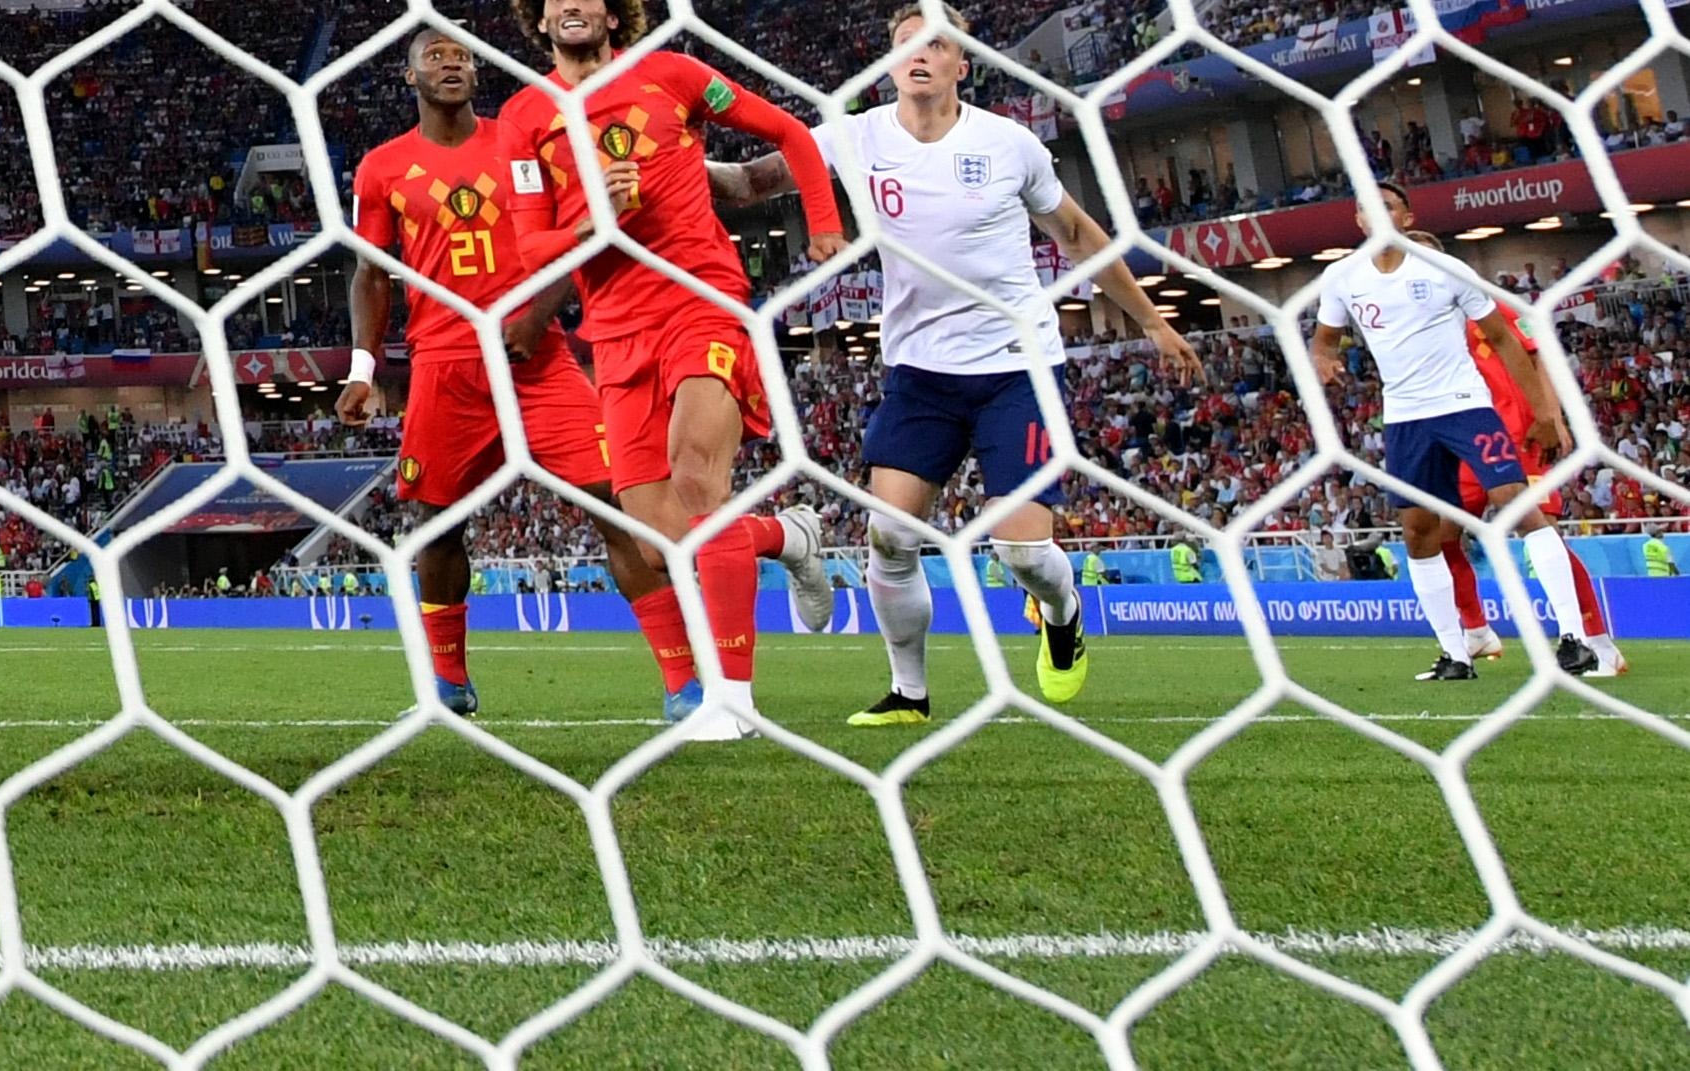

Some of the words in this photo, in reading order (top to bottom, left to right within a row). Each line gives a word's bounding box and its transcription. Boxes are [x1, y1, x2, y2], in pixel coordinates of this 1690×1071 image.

[868, 175, 904, 218] 16
[1454, 178, 1563, 211] #worldcup
[450, 230, 495, 276] 21
[1351, 303, 1385, 329] 22
[1474, 432, 1516, 464] 22
[1109, 601, 1208, 622] ЧЕМПИОНАТ
[1267, 600, 1294, 621] ПО
[1298, 599, 1383, 621] ФУТБОЛУ
